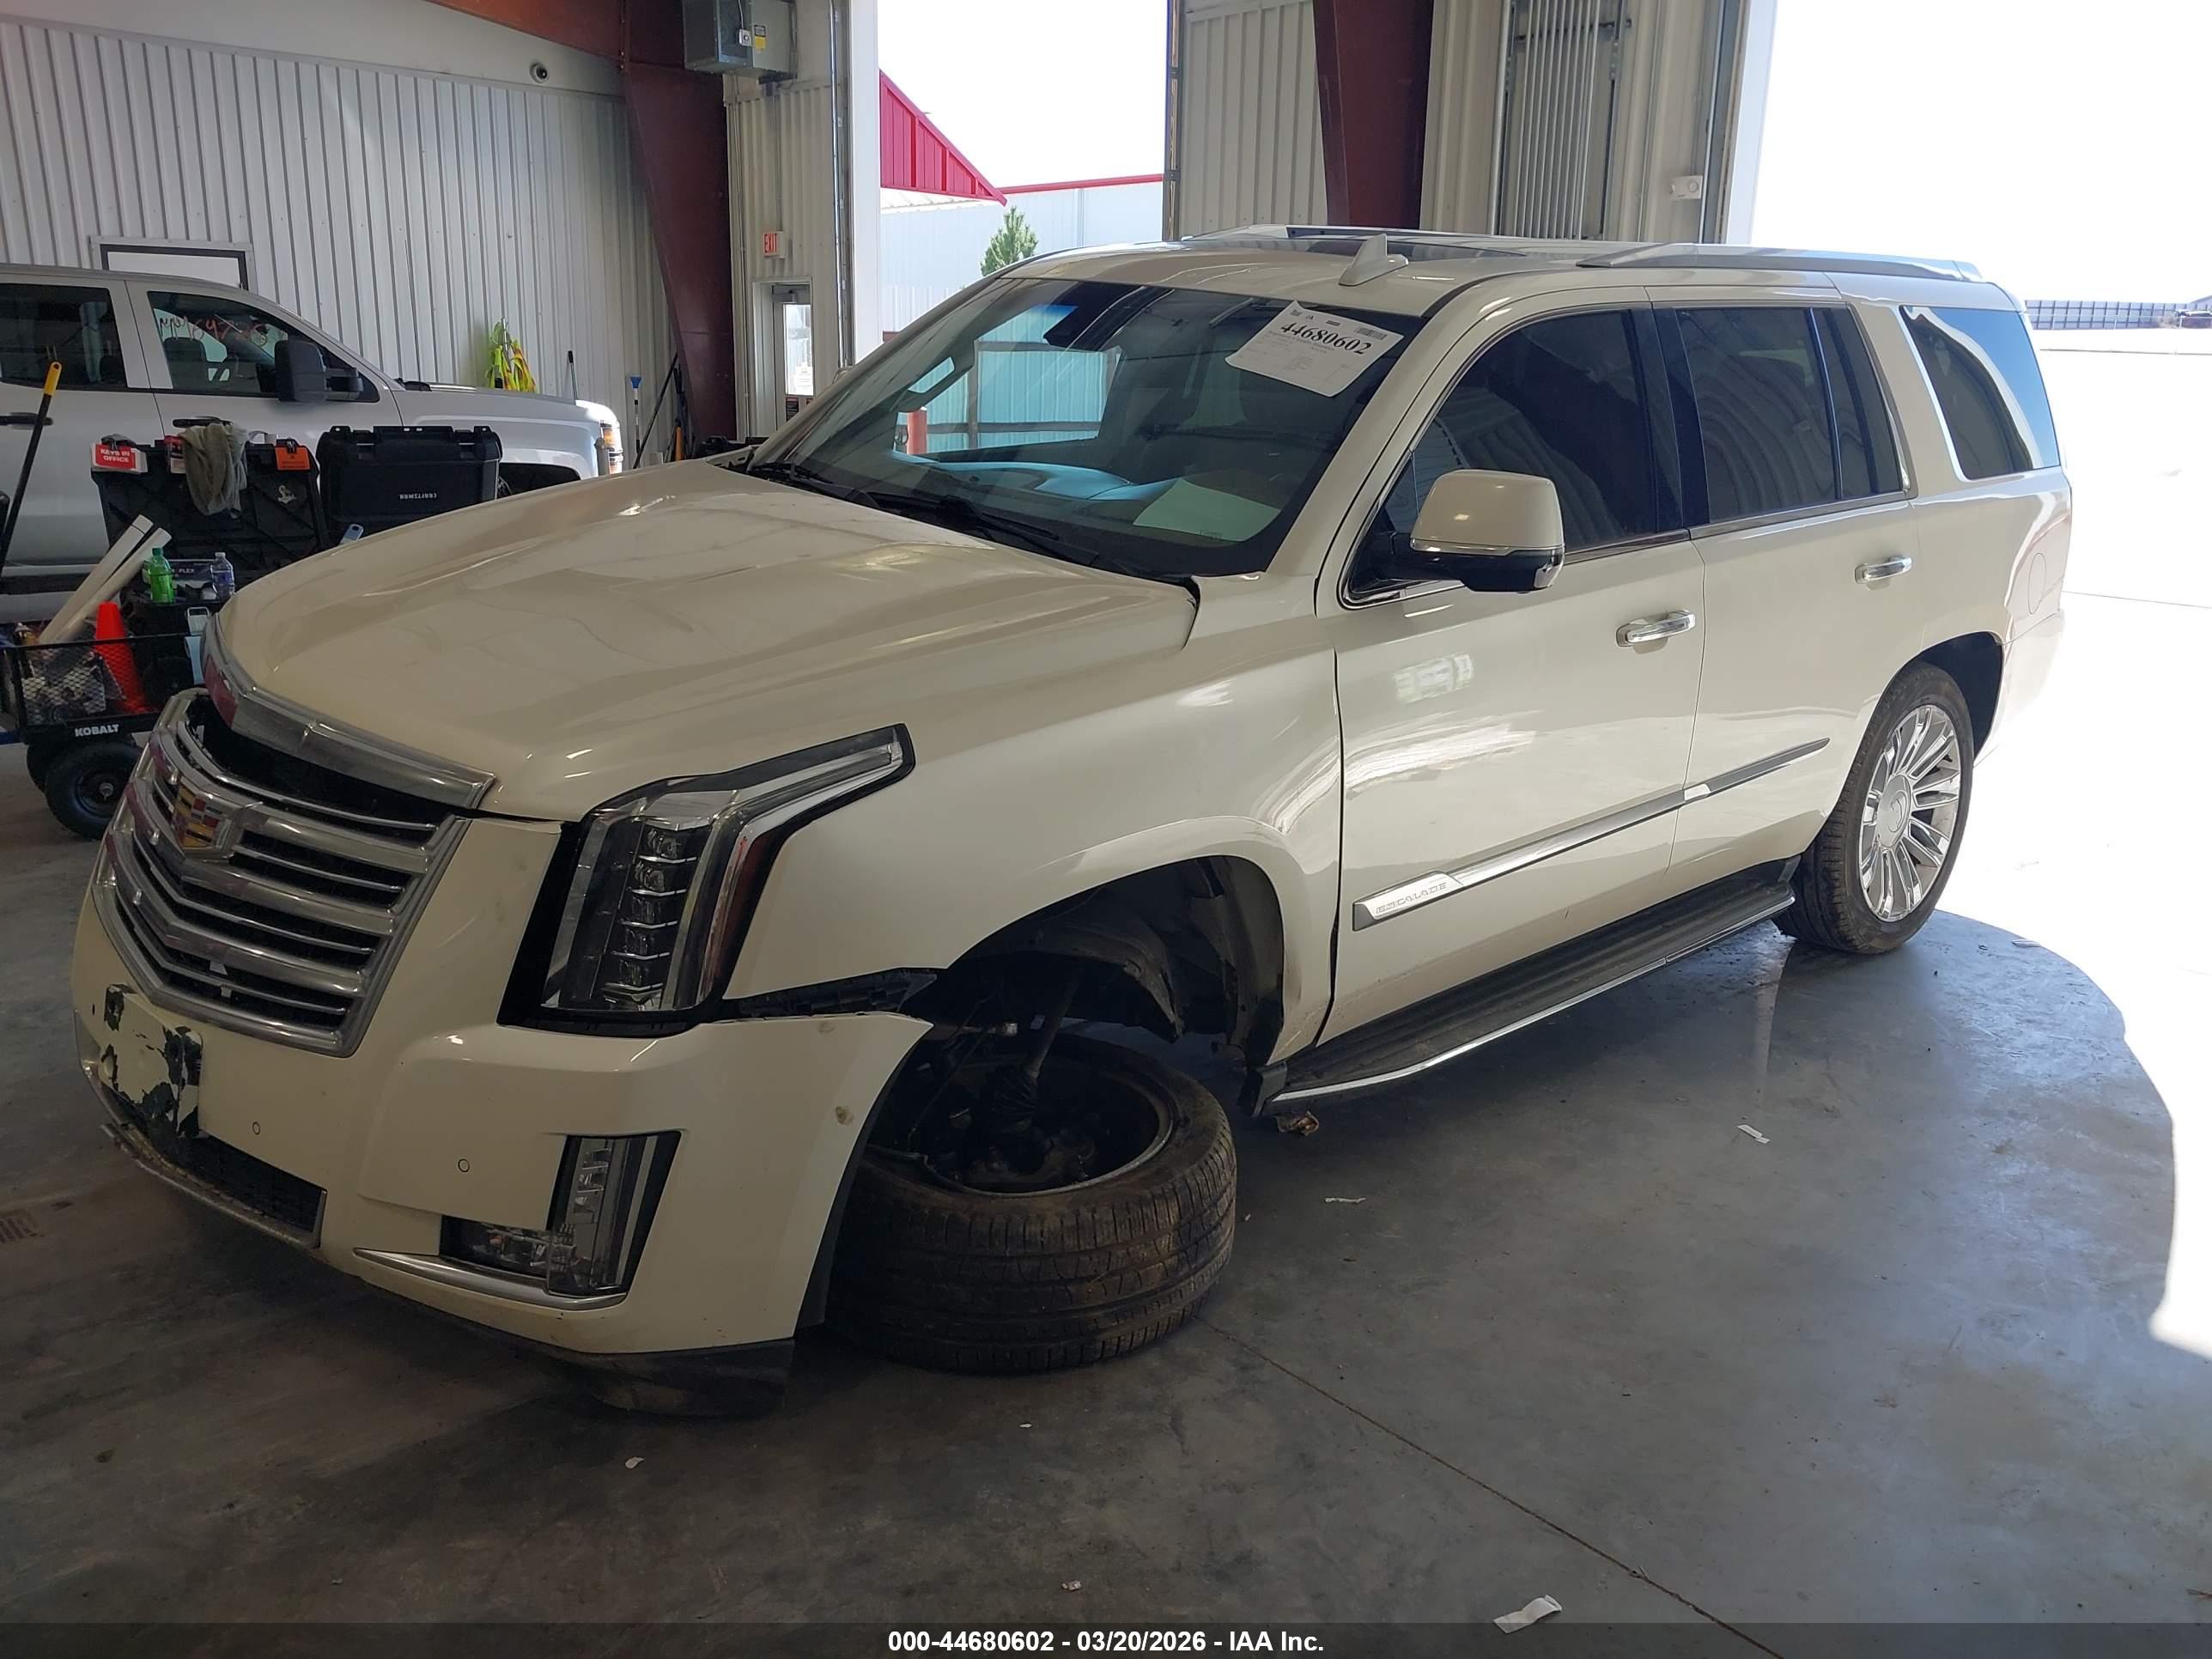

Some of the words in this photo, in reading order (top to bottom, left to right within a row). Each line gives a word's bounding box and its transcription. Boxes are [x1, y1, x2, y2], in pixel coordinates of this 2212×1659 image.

[764, 233, 777, 253] EXIT
[1280, 322, 1372, 356] 44680602
[100, 447, 120, 457] KEYS
[75, 724, 119, 737] KOBALT
[1375, 881, 1448, 915] ESCALADE
